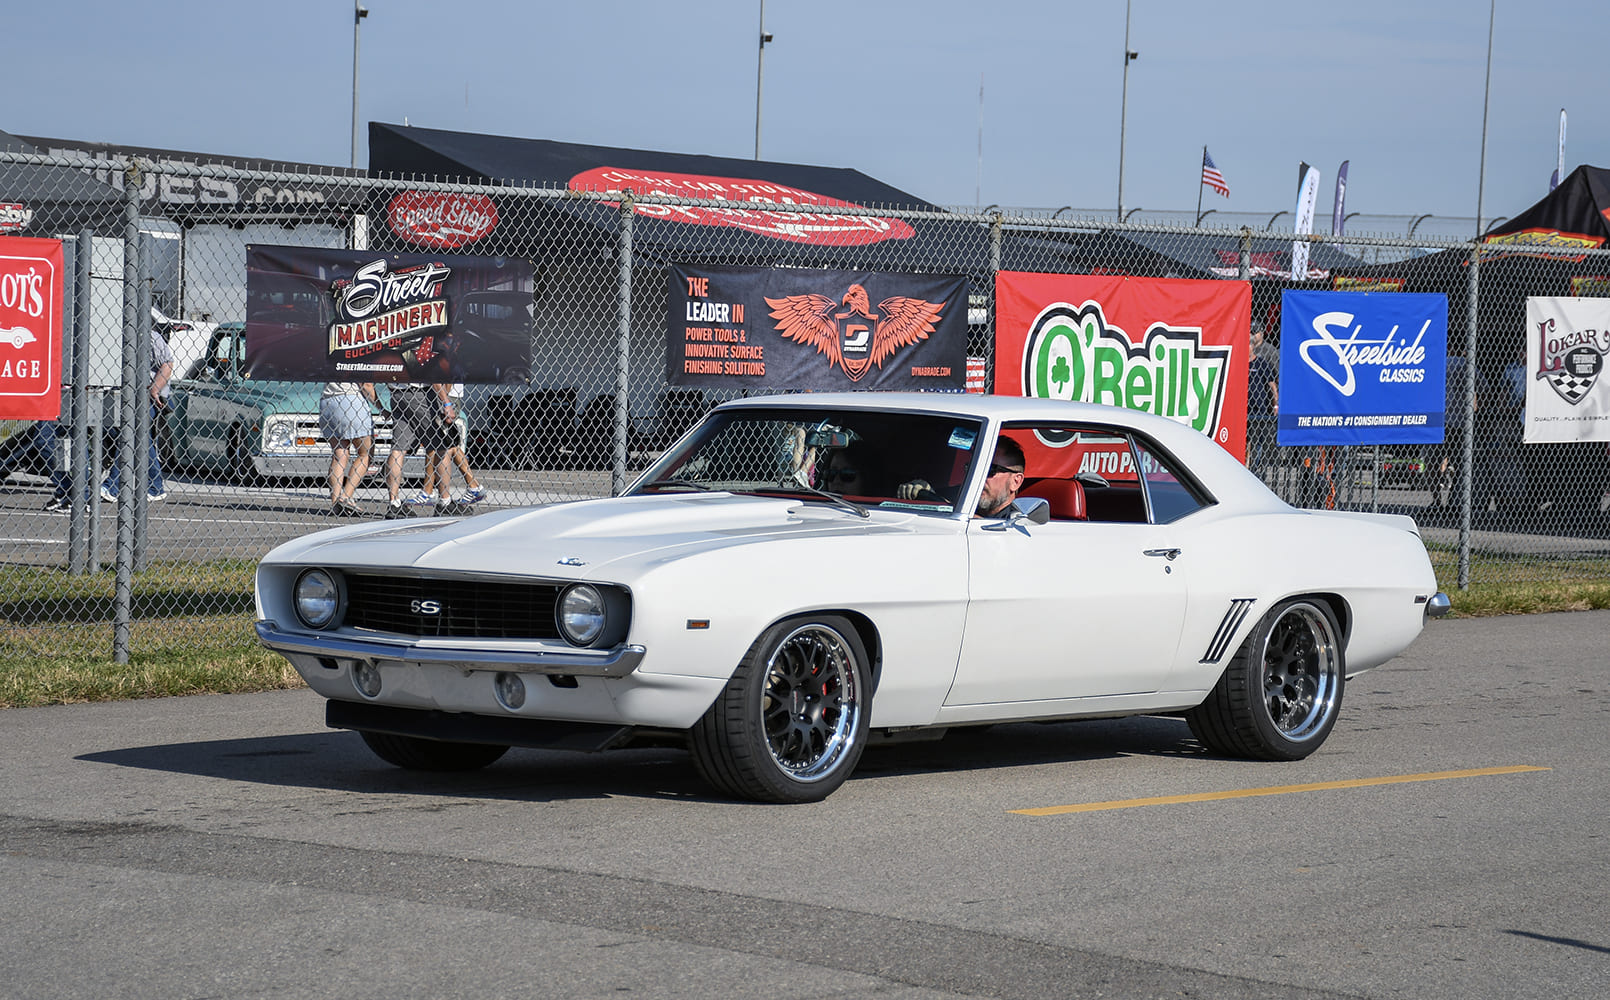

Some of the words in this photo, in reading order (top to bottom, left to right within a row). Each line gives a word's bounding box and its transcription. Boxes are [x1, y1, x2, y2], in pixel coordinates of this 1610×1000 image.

[683, 180, 728, 193] CAR
[446, 200, 491, 237] Shop
[0, 267, 43, 317] OT'S
[346, 259, 450, 317] Street
[686, 276, 709, 297] THE
[686, 301, 729, 323] LEADER
[731, 304, 744, 323] IN
[337, 302, 445, 345] MACHINERY
[388, 338, 402, 348] OH
[685, 327, 713, 341] POWER
[714, 328, 738, 343] TOOLS
[740, 329, 746, 343] &
[685, 343, 729, 358] INNOVATIVE
[730, 345, 764, 359] SURFACE
[1299, 311, 1432, 397] Streetside
[1536, 318, 1606, 373] LOKAR
[1, 359, 40, 378] AGE
[684, 360, 723, 374] FINISHING
[724, 361, 766, 376] SOLUTIONS
[911, 366, 951, 377] DYNABRADE.COM
[1036, 322, 1218, 431] O'Reilly
[1379, 368, 1425, 383] CLASSICS
[1298, 416, 1312, 427] THE
[1312, 416, 1343, 426] NATION'S
[1344, 416, 1353, 426] #1
[1354, 415, 1402, 426] CONSIGNMENT
[1402, 415, 1428, 425] DEALER
[1079, 451, 1119, 474] AUTO
[410, 600, 440, 614] SS
